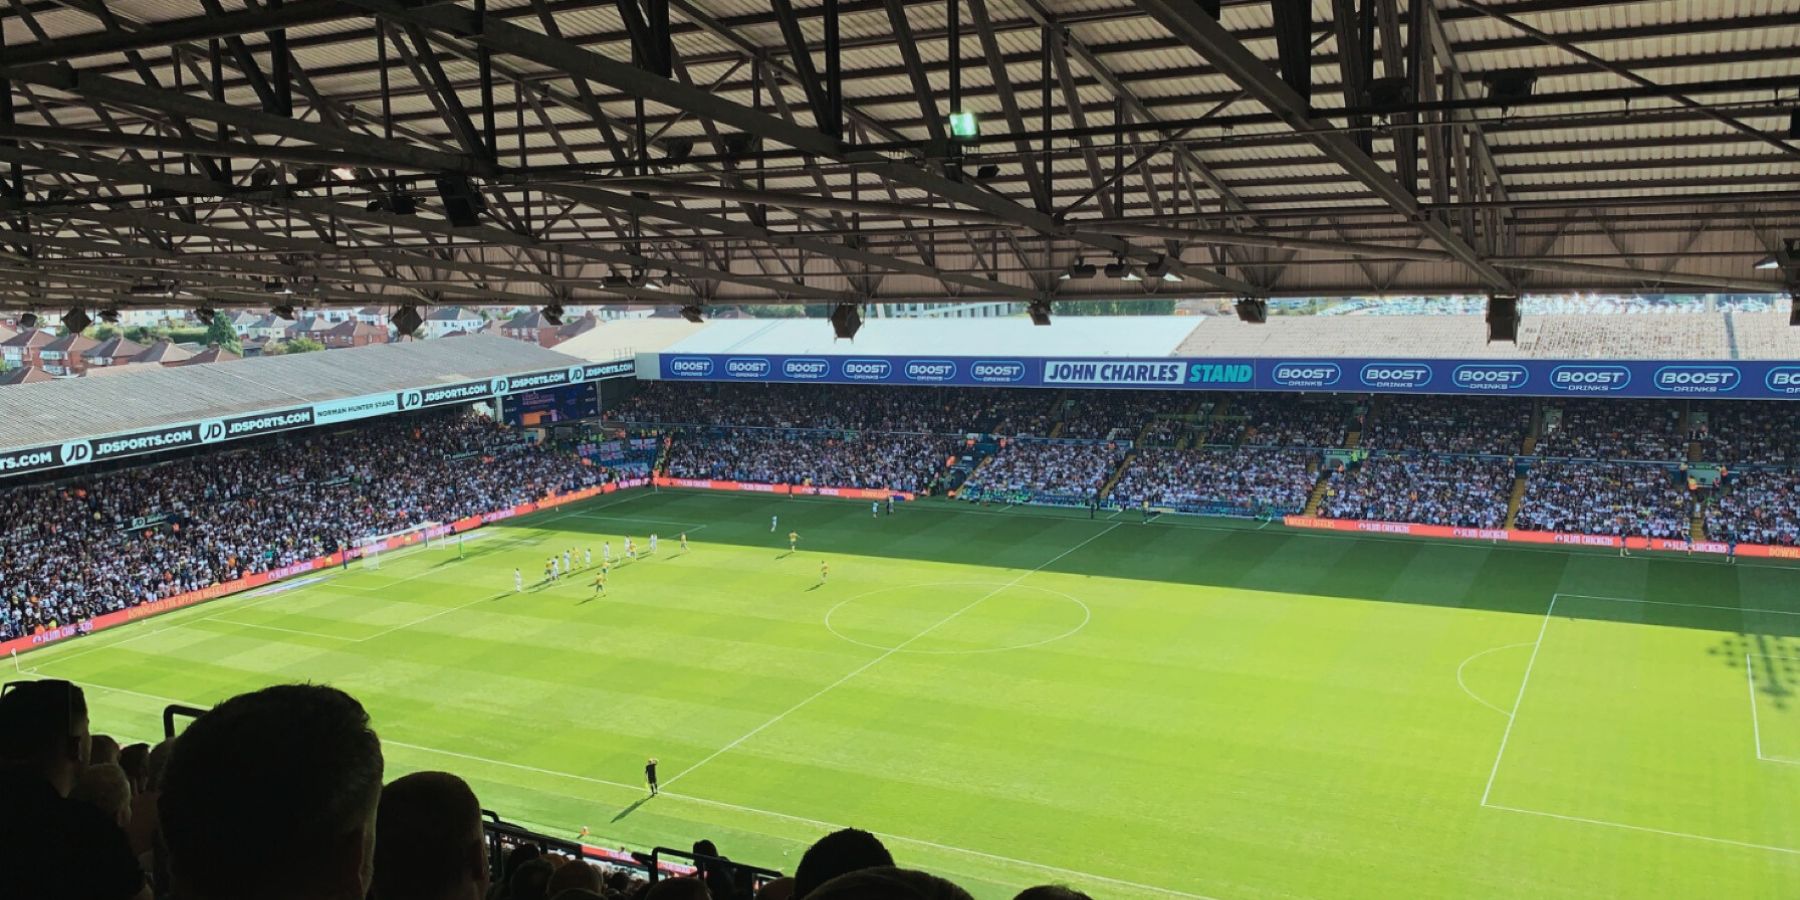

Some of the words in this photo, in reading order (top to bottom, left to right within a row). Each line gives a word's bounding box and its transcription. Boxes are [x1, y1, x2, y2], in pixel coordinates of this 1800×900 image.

[585, 363, 633, 377] JDSPORTS.COM
[674, 361, 710, 371] BOOST
[729, 362, 767, 372] BOOST
[786, 363, 825, 373] BOOST
[846, 364, 887, 373] BOOST
[909, 365, 952, 374] BOOST
[975, 366, 1020, 375] BOOST
[1048, 364, 1097, 380] JOHN
[1099, 364, 1179, 381] CHARLES
[1189, 364, 1253, 382] STAND
[1277, 368, 1335, 379] BOOST
[1366, 369, 1427, 380] BOOST
[1458, 370, 1522, 381] BOOST
[1556, 371, 1624, 383] BOOST
[1661, 372, 1733, 384] BOOST
[509, 373, 565, 389] JDSPORTS.COM
[424, 385, 487, 402] JDSPORTS.COM
[317, 407, 347, 417] NORMAN
[348, 402, 374, 412] HUNTER
[374, 399, 395, 408] STAND
[228, 412, 310, 433] JDSPORTS.COM
[96, 429, 192, 455] JDSPORTS.COM
